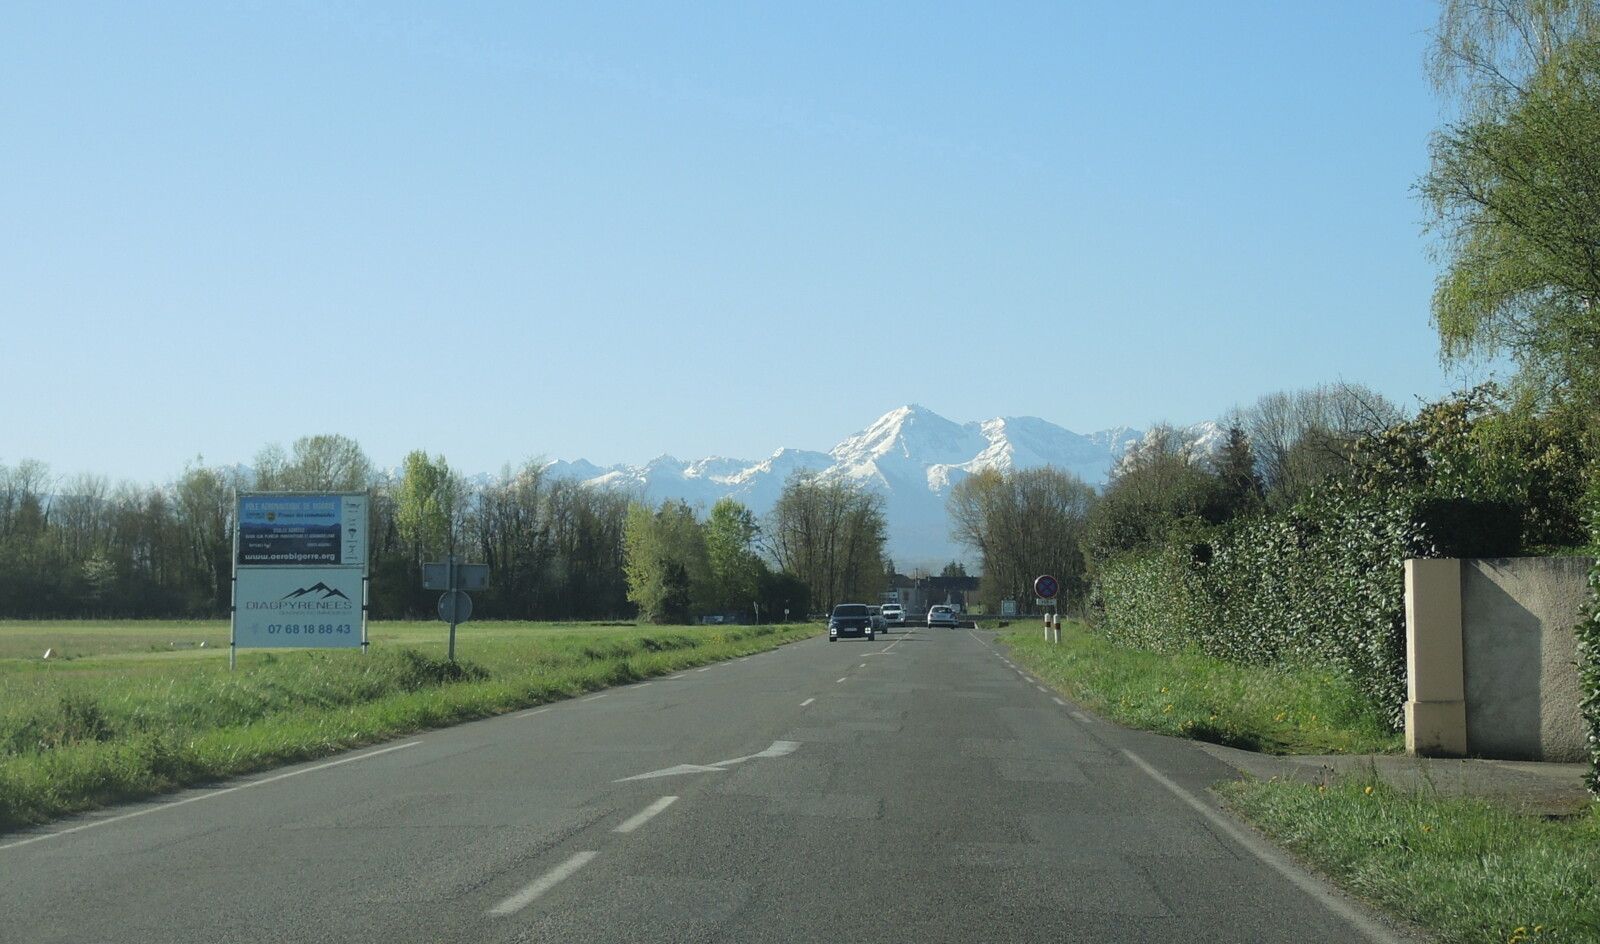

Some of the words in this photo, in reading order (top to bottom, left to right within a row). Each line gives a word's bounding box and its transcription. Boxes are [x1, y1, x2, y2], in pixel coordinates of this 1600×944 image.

[245, 553, 335, 561] www.aerobigorre.org
[268, 624, 282, 635] 07
[285, 624, 300, 635] 68
[304, 624, 315, 635] 18
[318, 624, 333, 635] 88
[335, 624, 351, 635] 43
